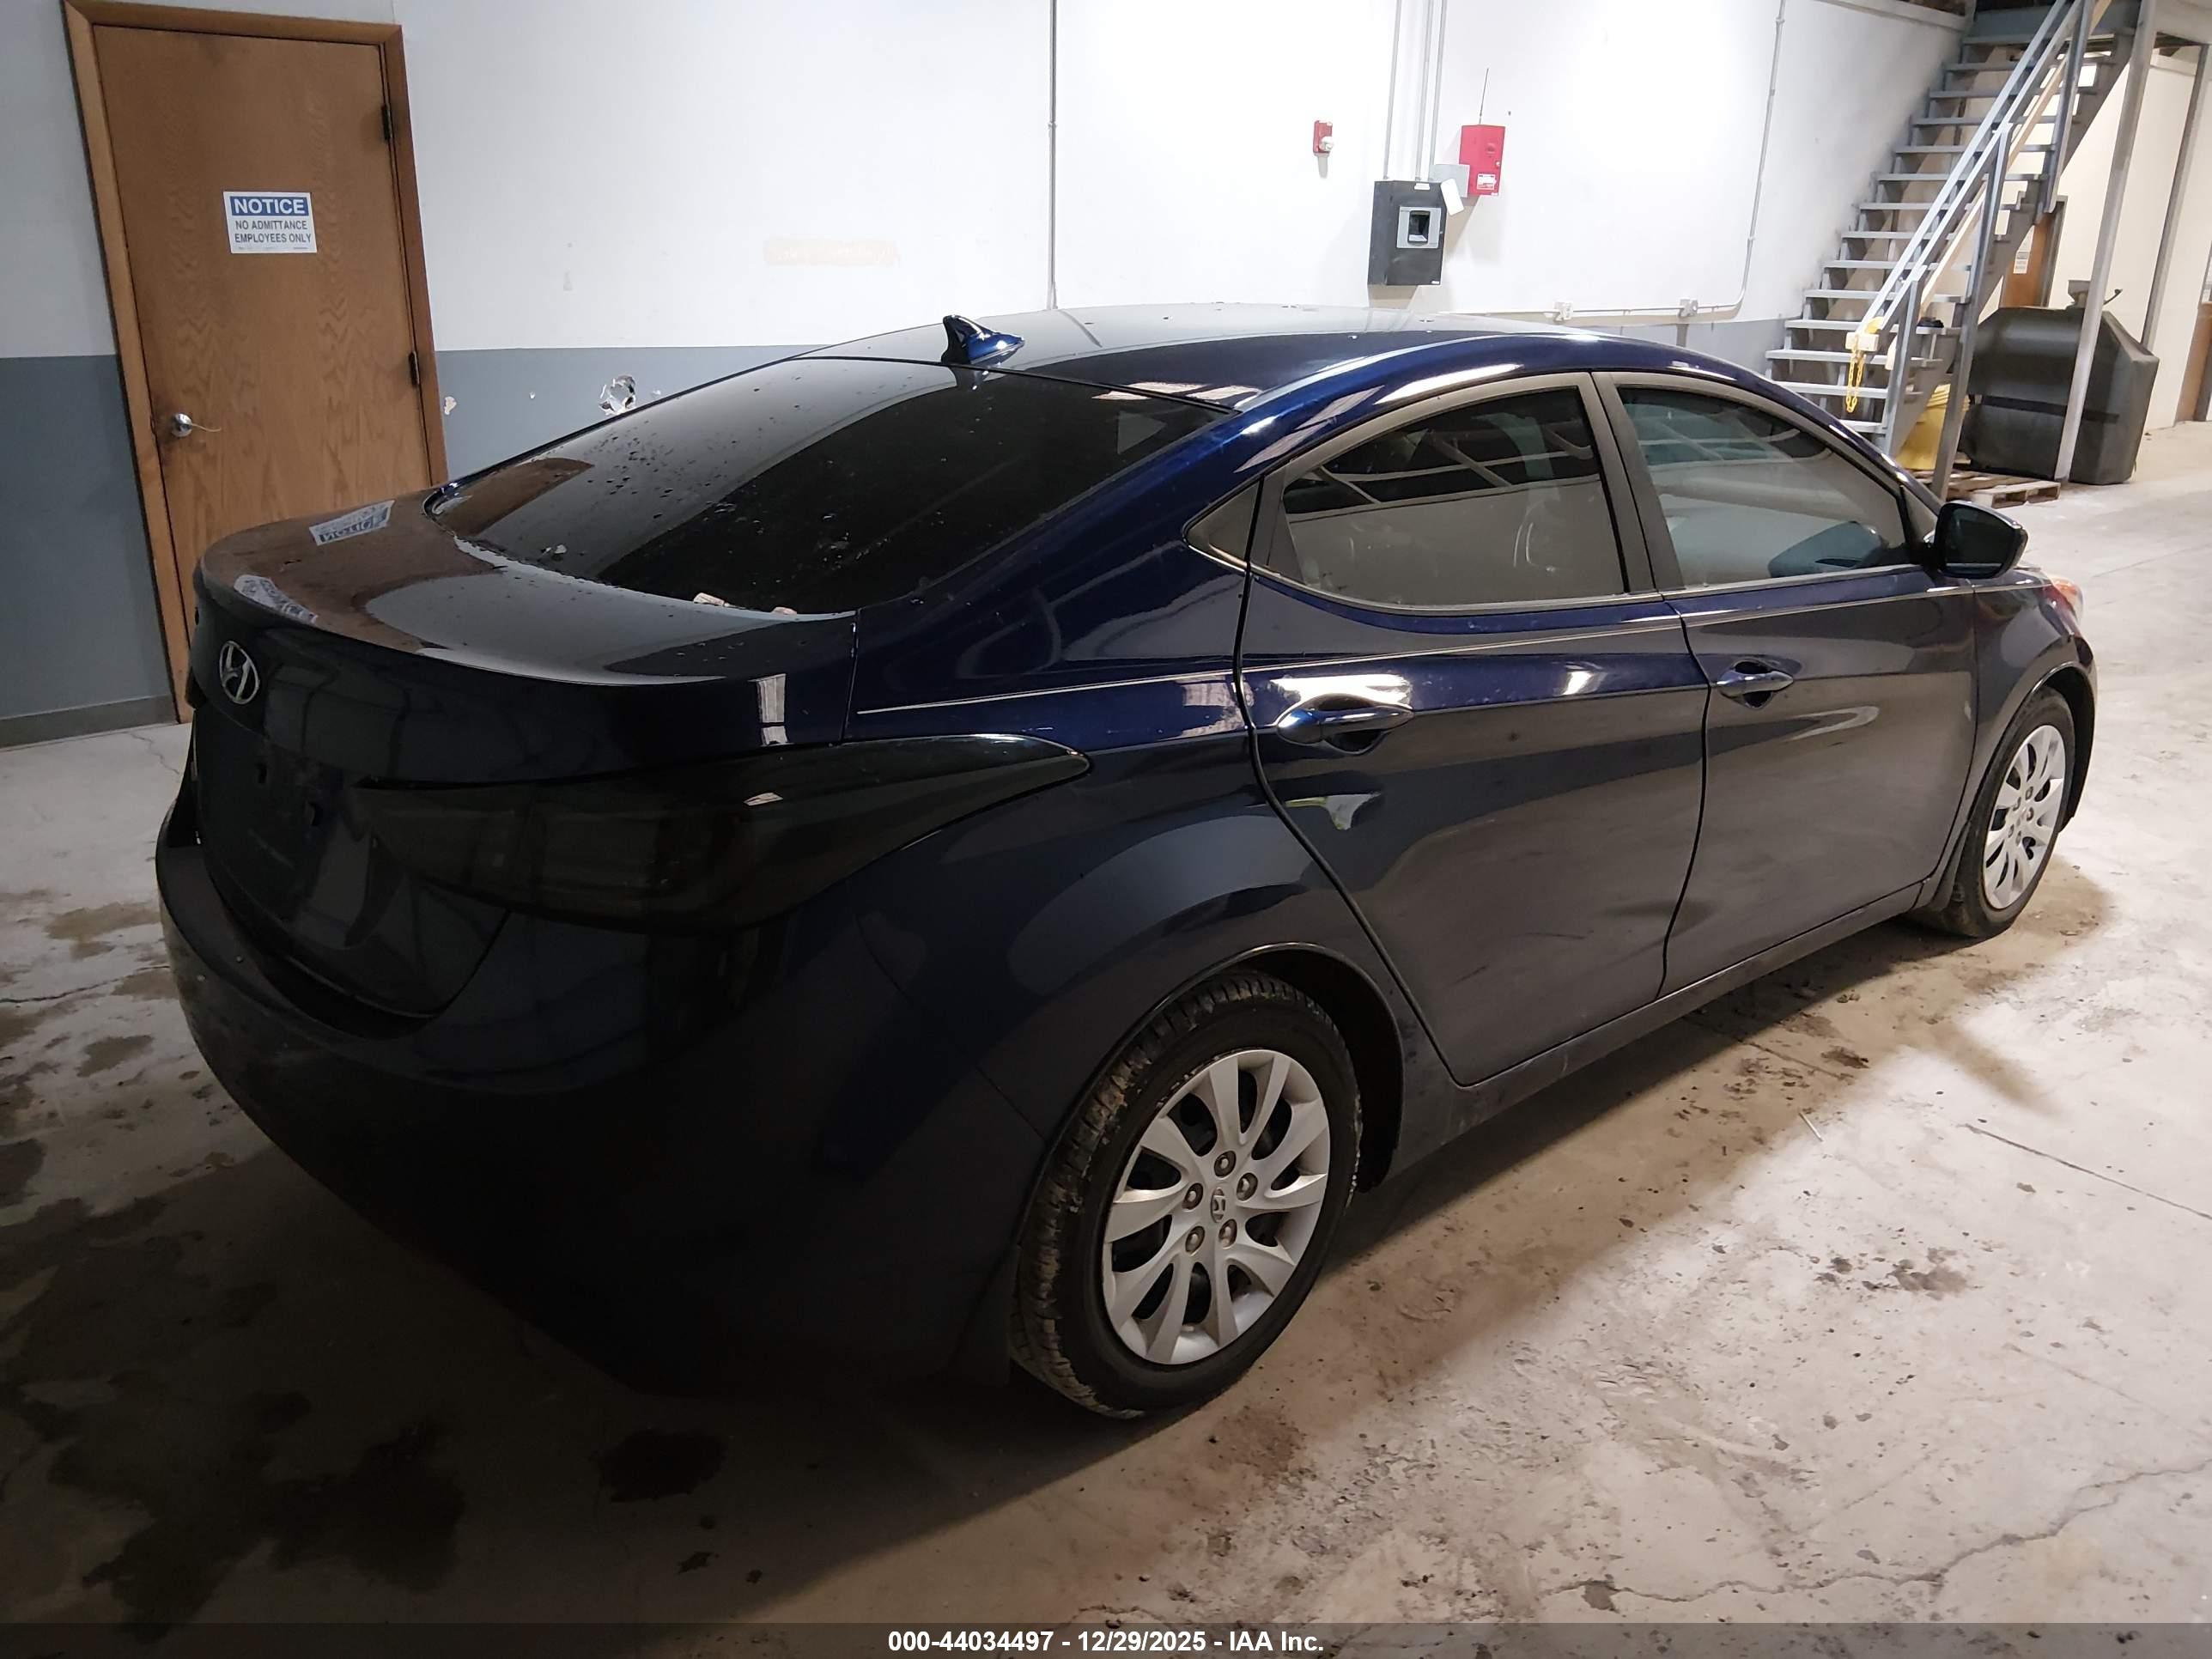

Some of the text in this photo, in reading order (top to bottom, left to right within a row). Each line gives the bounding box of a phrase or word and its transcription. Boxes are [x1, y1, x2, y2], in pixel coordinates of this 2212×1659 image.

[234, 198, 306, 215] NOTICE
[235, 220, 308, 230] NO ADMITTANCE
[234, 233, 312, 243] EMPLOYEES ONLY
